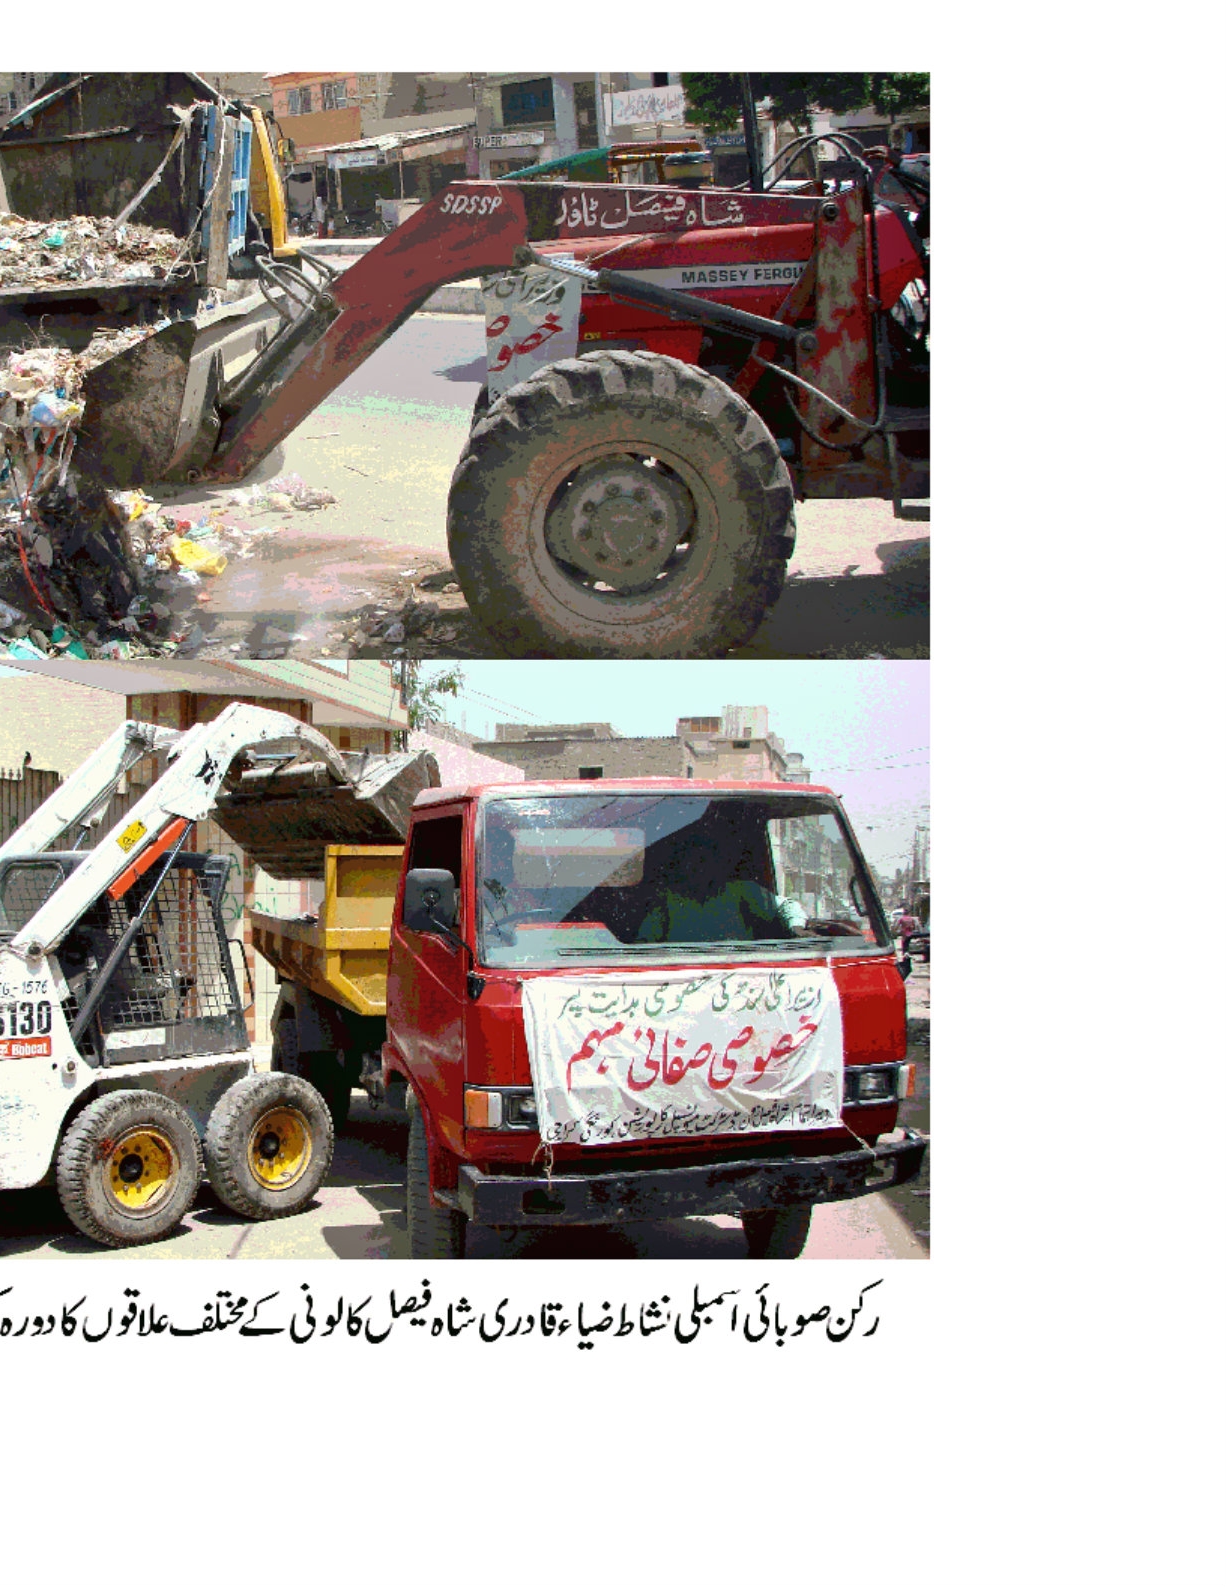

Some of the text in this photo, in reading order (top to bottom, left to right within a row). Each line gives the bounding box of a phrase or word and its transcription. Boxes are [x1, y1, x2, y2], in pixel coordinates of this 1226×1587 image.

[440, 193, 502, 214] SDSSP
[601, 191, 685, 229] فیصل
[686, 195, 744, 226] شاہ
[681, 267, 804, 283] MASSEY FERGU
[11, 1043, 48, 1056] Bobcat
[566, 1015, 819, 1093] خصوصی صفائی مہم
